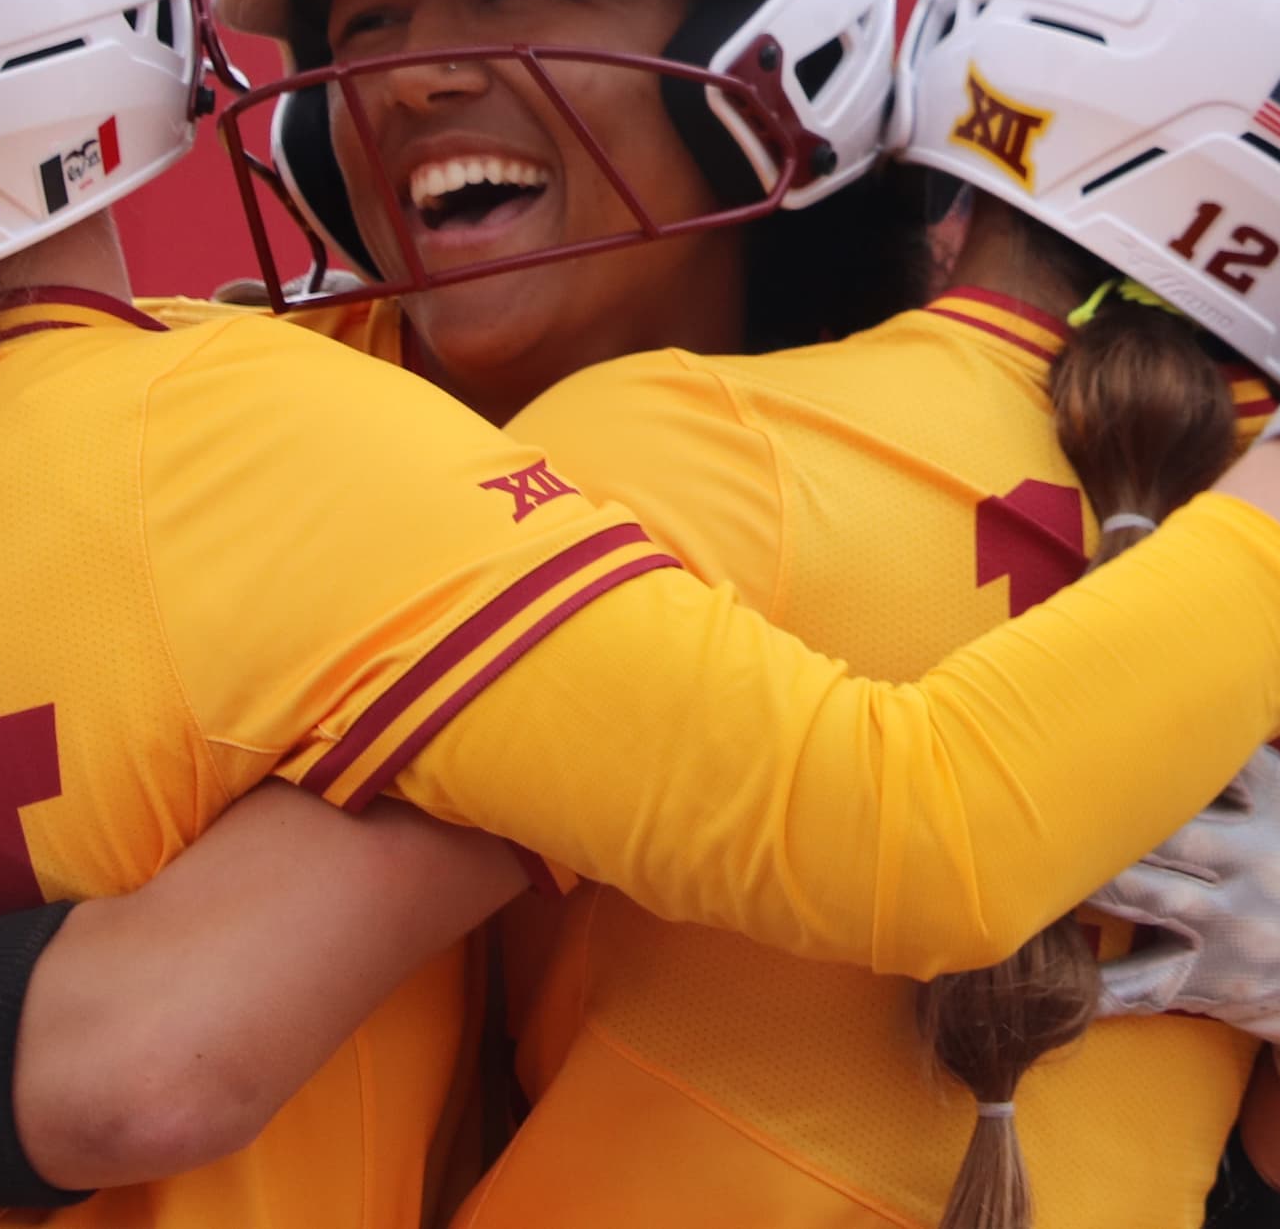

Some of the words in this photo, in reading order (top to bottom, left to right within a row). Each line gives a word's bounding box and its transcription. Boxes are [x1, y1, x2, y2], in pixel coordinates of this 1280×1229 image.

[950, 64, 1051, 189] XII
[1167, 201, 1280, 295] 12
[477, 457, 582, 524] XII
